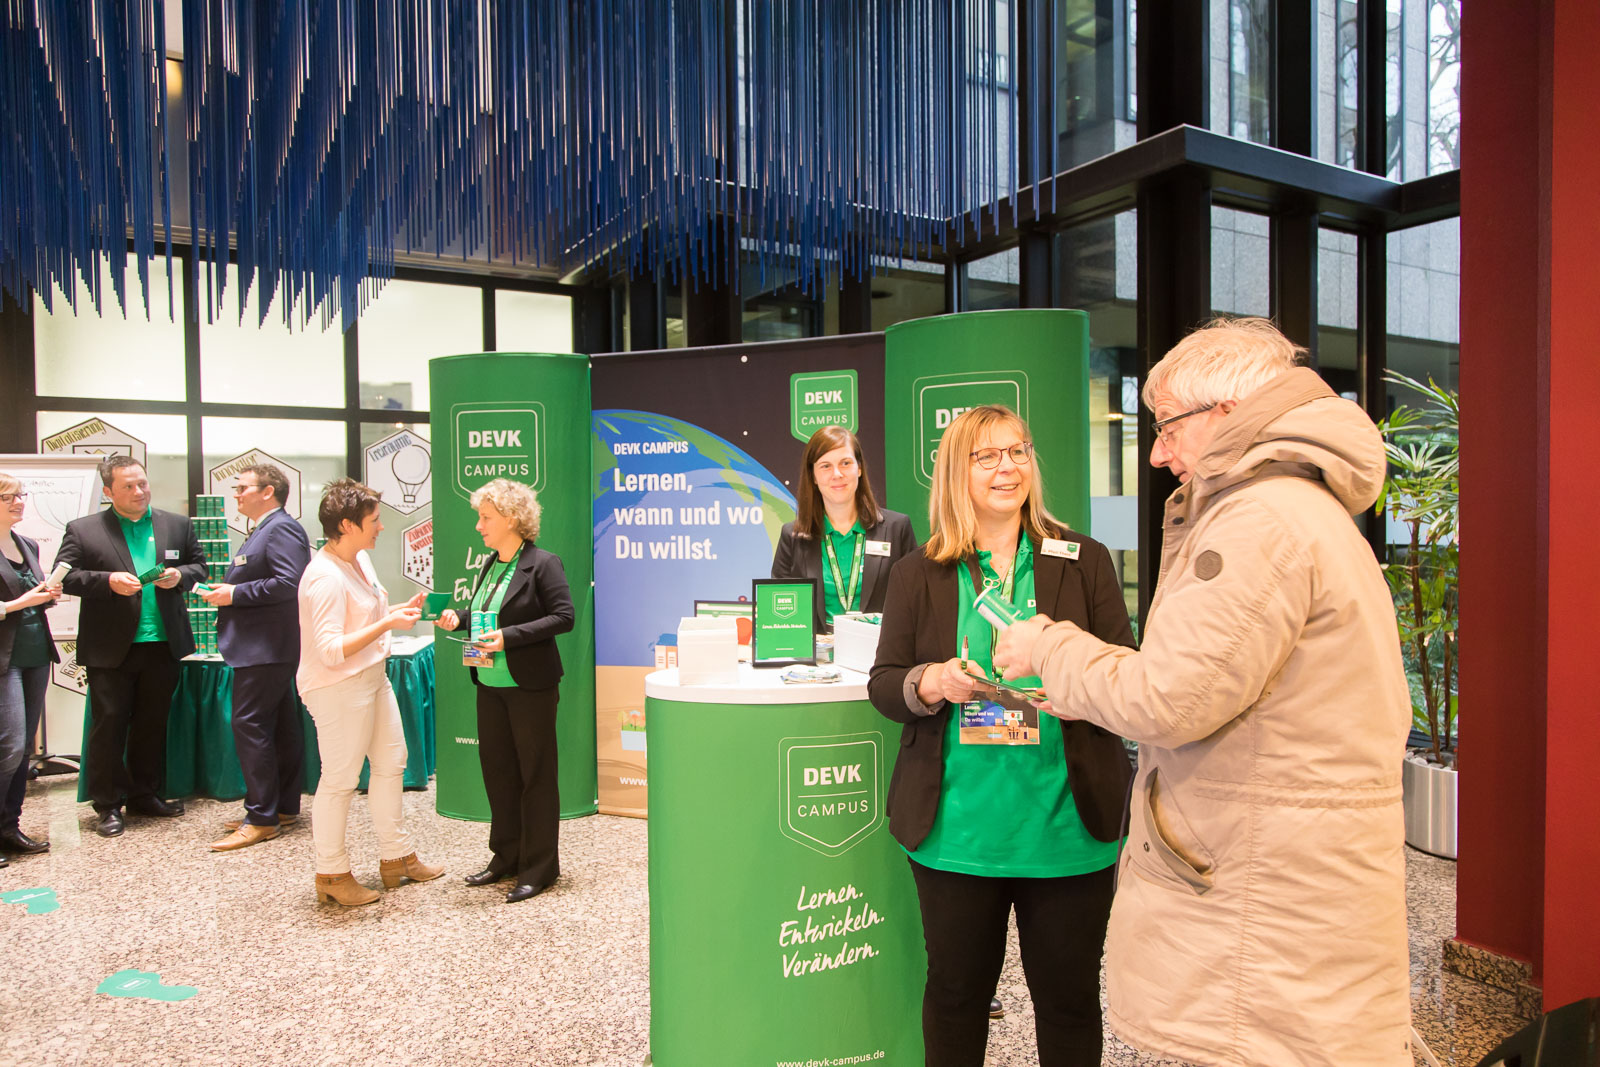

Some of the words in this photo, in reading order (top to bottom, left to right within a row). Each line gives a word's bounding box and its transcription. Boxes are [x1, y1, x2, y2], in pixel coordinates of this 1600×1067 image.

[804, 390, 843, 405] DEVK
[801, 414, 848, 426] CAMPUS
[468, 430, 522, 448] DEVK
[613, 443, 641, 455] DEVK
[642, 441, 689, 454] CAMPUS
[464, 463, 529, 477] CAMPUS
[613, 467, 693, 494] Lernen,
[613, 507, 674, 526] wann
[680, 500, 720, 525] und
[727, 506, 764, 525] wo
[615, 535, 643, 559] Du
[648, 535, 718, 560] willst.
[803, 764, 862, 786] DEVK
[797, 800, 869, 818] CAMPUS
[797, 884, 864, 911] Lernen.
[779, 902, 885, 947] Entwickeln.
[782, 941, 880, 978] Verändern.
[777, 1050, 885, 1067] www.devk-campus.de
